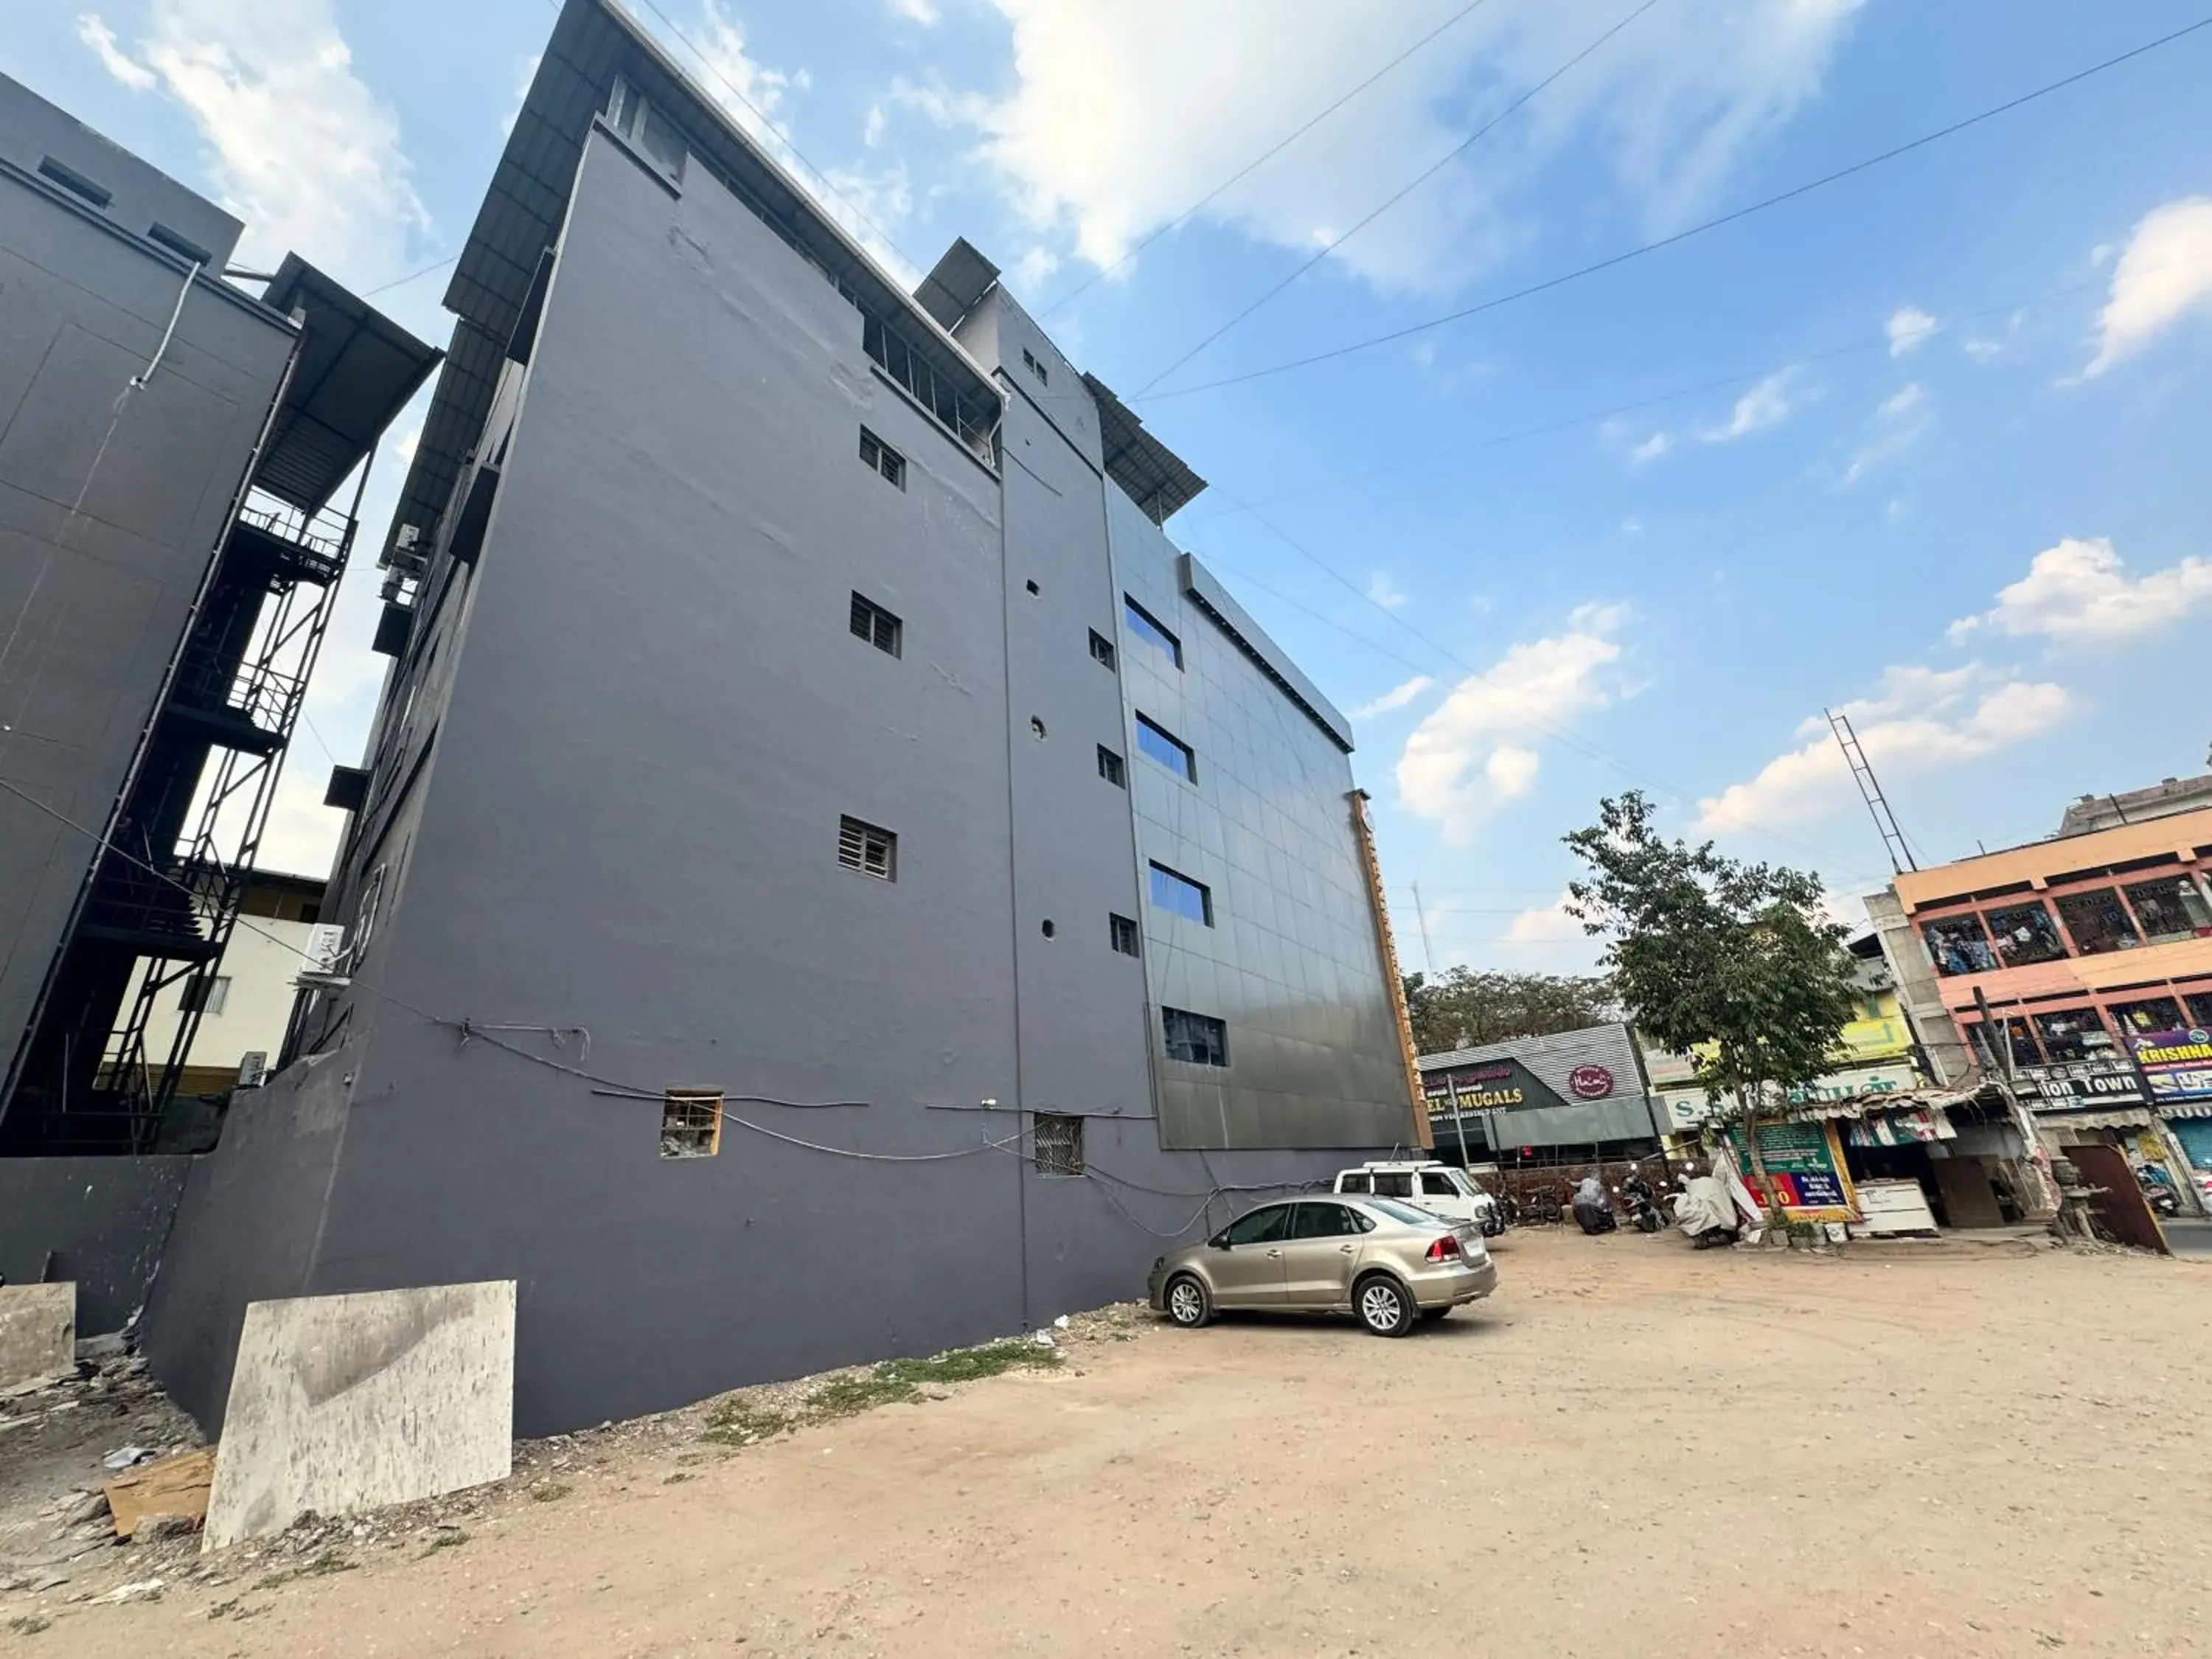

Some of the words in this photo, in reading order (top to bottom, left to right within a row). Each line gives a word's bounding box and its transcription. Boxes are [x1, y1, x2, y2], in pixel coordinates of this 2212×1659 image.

[2136, 1043, 2212, 1064] KRISHNA
[2083, 1076, 2138, 1093] Town
[1458, 1088, 1523, 1109] MUGALS
